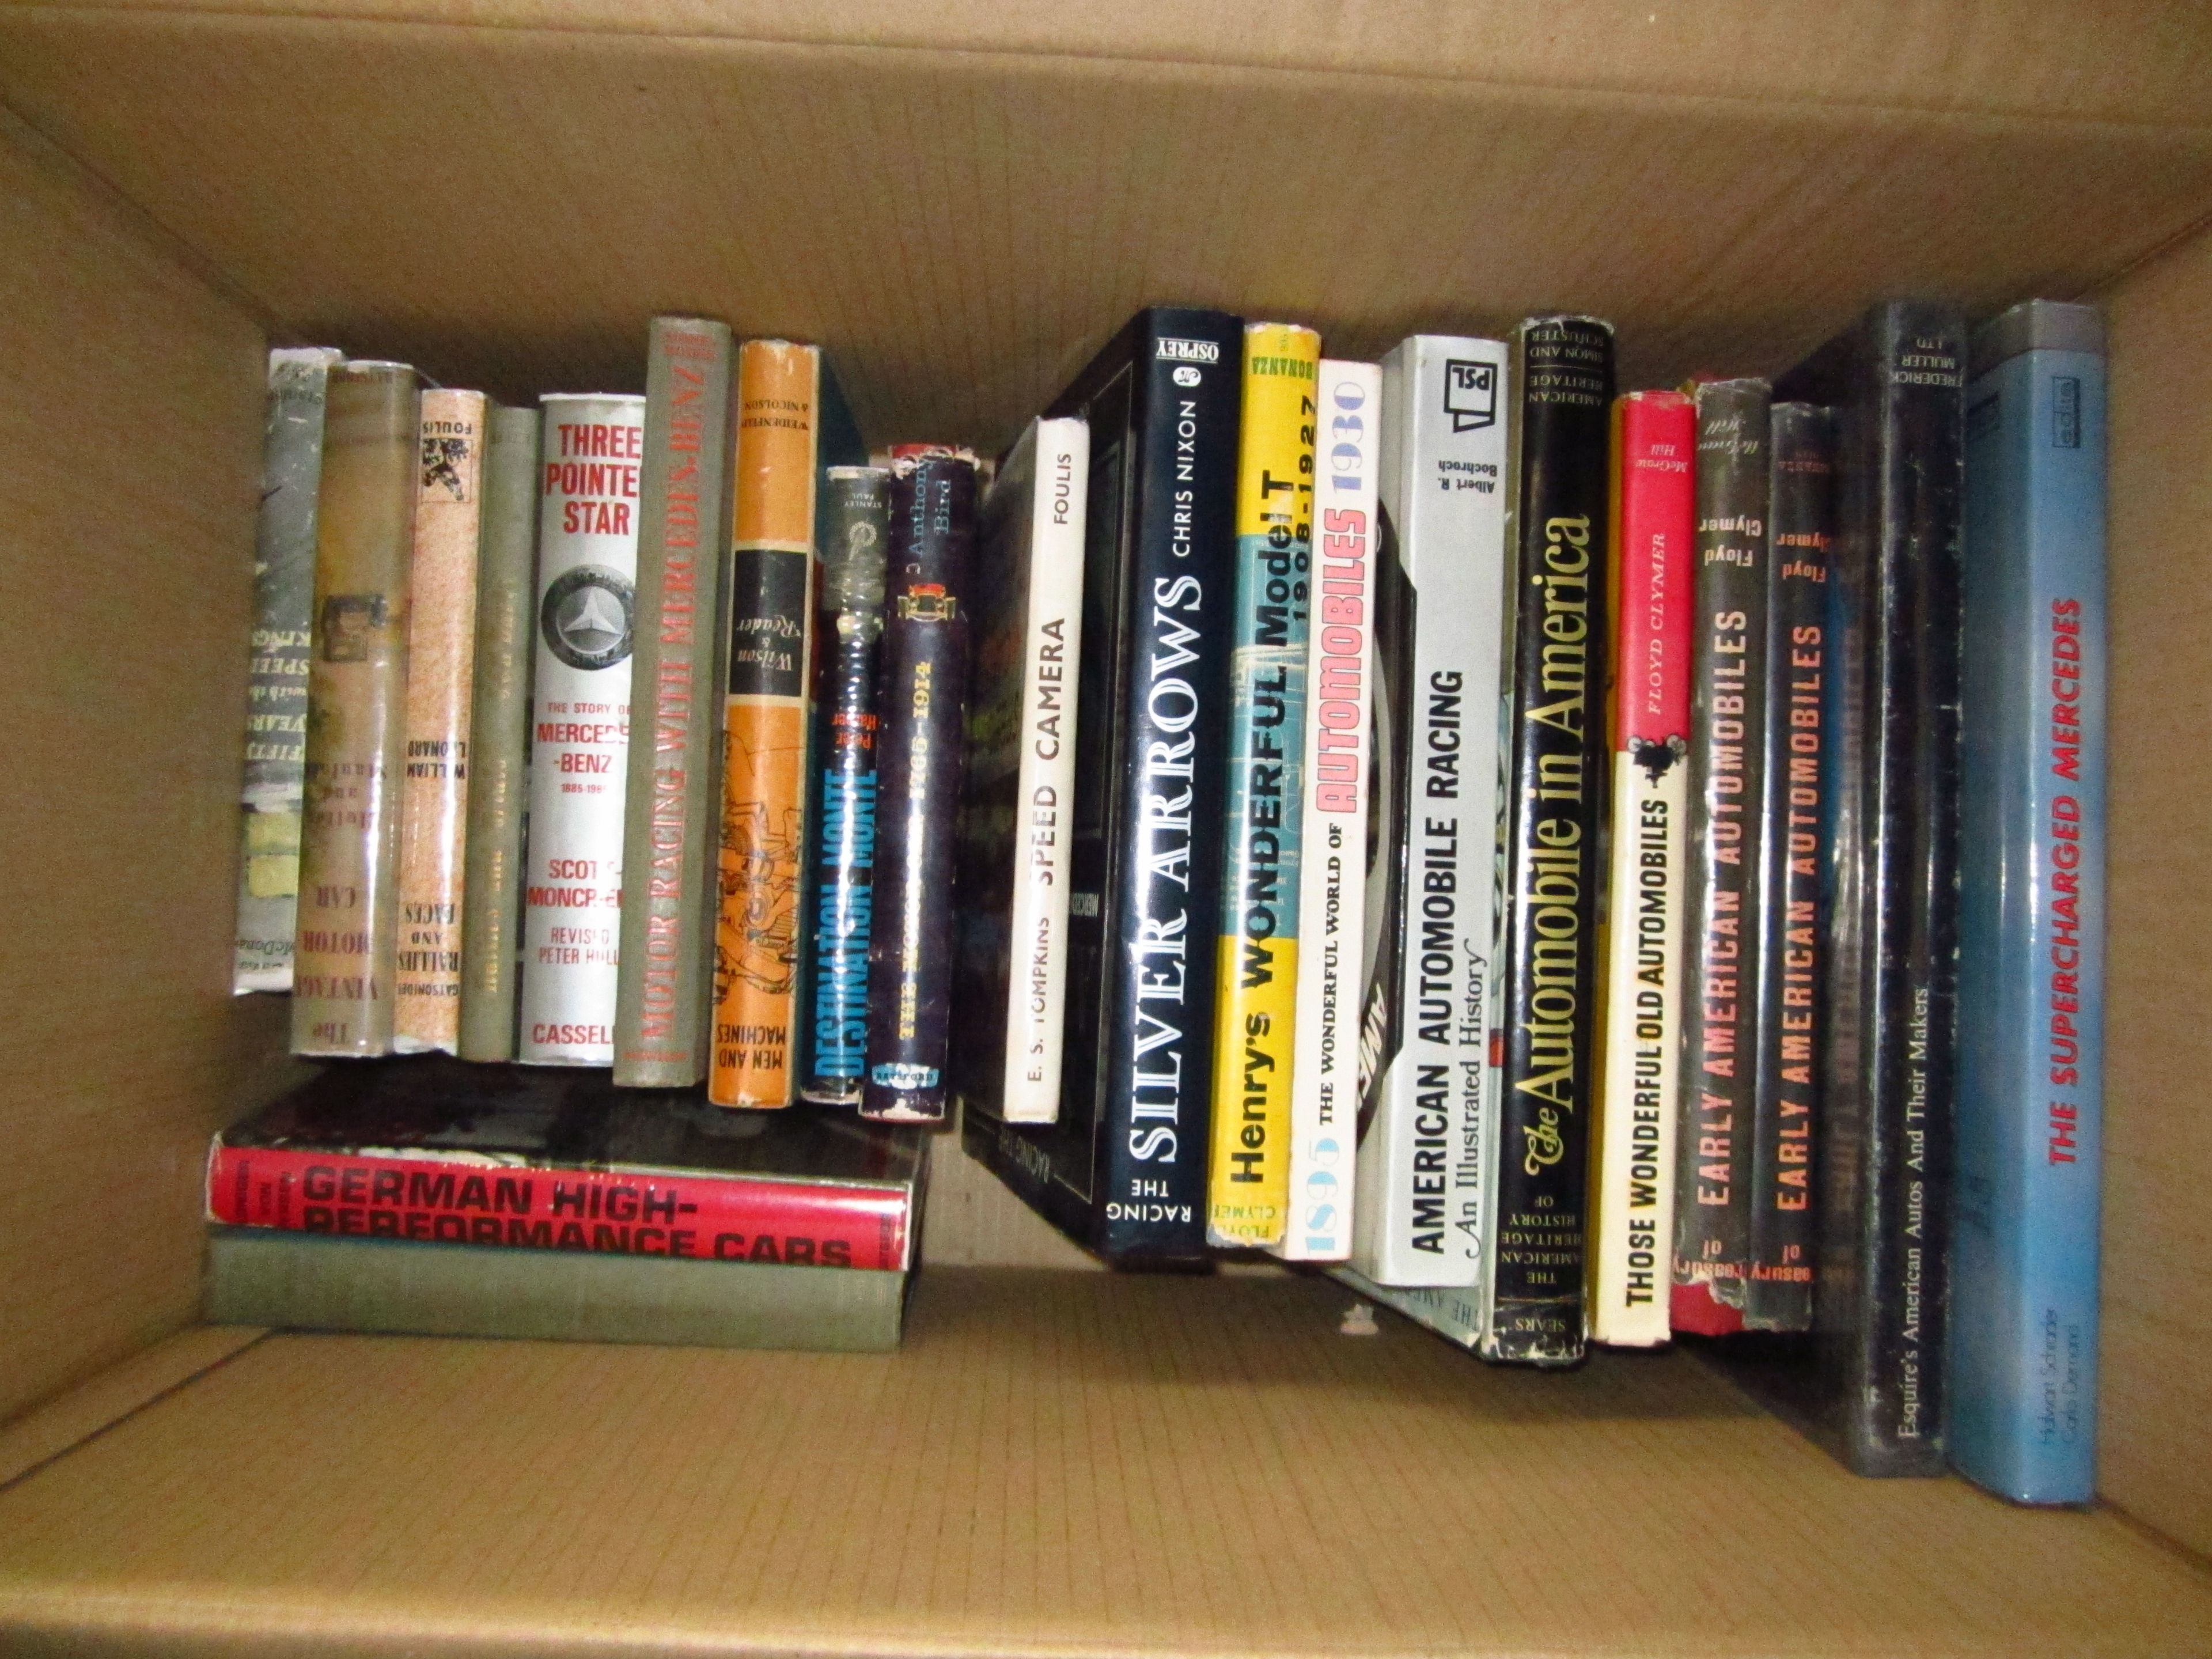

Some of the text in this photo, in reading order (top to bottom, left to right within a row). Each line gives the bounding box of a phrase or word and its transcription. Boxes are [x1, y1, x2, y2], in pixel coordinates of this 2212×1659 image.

[1157, 338, 1219, 361] OSPREY
[1451, 366, 1492, 391] PSL
[422, 421, 473, 435] FOULIS
[558, 423, 642, 459] THREE
[546, 463, 641, 498] POINTE
[1172, 400, 1197, 558] CHRIS NIXON
[1260, 469, 1294, 499] T
[1437, 459, 1498, 478] Bochroch
[1437, 476, 1495, 495] Albert R.
[1052, 453, 1072, 526] FOULIS
[563, 501, 630, 536] STAR
[1292, 394, 1317, 622] 1908-1927
[1699, 518, 1763, 536] Clymer
[1703, 550, 1755, 567] Floyd
[1782, 560, 1826, 584] Floyd
[1255, 512, 1294, 647] Model
[736, 614, 801, 638] Reader
[1647, 532, 1666, 715] FLOYD CLYMER
[737, 649, 793, 671] Wilson
[761, 637, 771, 648] &
[654, 661, 694, 752] WITH
[1035, 618, 1065, 761] CAMERA
[547, 702, 568, 714] THE
[574, 702, 611, 714] STORY
[1426, 670, 1463, 800] RACING
[406, 763, 465, 780] WLLIAM
[647, 769, 687, 900] RACING
[1029, 785, 1057, 887] SPEED
[1238, 665, 1287, 989] WONDERFUL
[1305, 381, 1366, 1256] 1895 THE WONDERFUL WORLD OF AUTOMOBILES 1930
[898, 981, 917, 1040] THE
[908, 661, 931, 800] 1765-1914
[1515, 513, 1592, 1176] The Automobile in America
[1128, 575, 1202, 1162] SILVER ARROWS
[2048, 598, 2081, 1165] THE SUPERCHARGED MERCEDES
[814, 769, 878, 1078] DESTINATION MONTE
[1697, 610, 1748, 1206] EARLY AMERICAN AUTOMOBILES
[1776, 625, 1821, 1211] EARLY AMERICAN AUTOMOBILES
[1418, 816, 1458, 1046] AUTOMOBILE
[539, 946, 579, 965] PETER
[640, 915, 679, 1037] MOTOR
[532, 1024, 614, 1044] CASSEL
[717, 1024, 786, 1046] MACHINES
[1908, 987, 1928, 1060] Makers
[718, 1048, 783, 1070] MEN AND
[1029, 1038, 1044, 1055] S.
[1625, 799, 1668, 1308] THOSE WONDERFUL OLD AUTOMOBILES
[1026, 1066, 1043, 1082] E.
[1229, 1012, 1276, 1183] Henry's
[1455, 937, 1487, 1259] An Illustrated History
[1906, 1067, 1926, 1122] Their
[1411, 1065, 1450, 1255] AMERICAN
[1906, 1129, 1924, 1172] And
[302, 1164, 533, 1215] GERMAN
[551, 1181, 698, 1225] HIGH-
[1130, 1179, 1169, 1197] THE
[1534, 1195, 1554, 1208] OF
[1105, 1202, 1191, 1222] RACING
[1509, 1213, 1576, 1228] HISTORY
[1904, 1181, 1923, 1238] Autos
[302, 1205, 698, 1257] PERFORMANCE
[714, 1232, 851, 1268] CARS
[1702, 1239, 1723, 1260] of
[1782, 1244, 1801, 1265] of
[1501, 1251, 1580, 1265] AMERICAN
[1673, 1251, 1747, 1278] reasury
[1526, 1271, 1556, 1285] THE
[1902, 1247, 1921, 1342] American
[1514, 1318, 1566, 1333] SEARS
